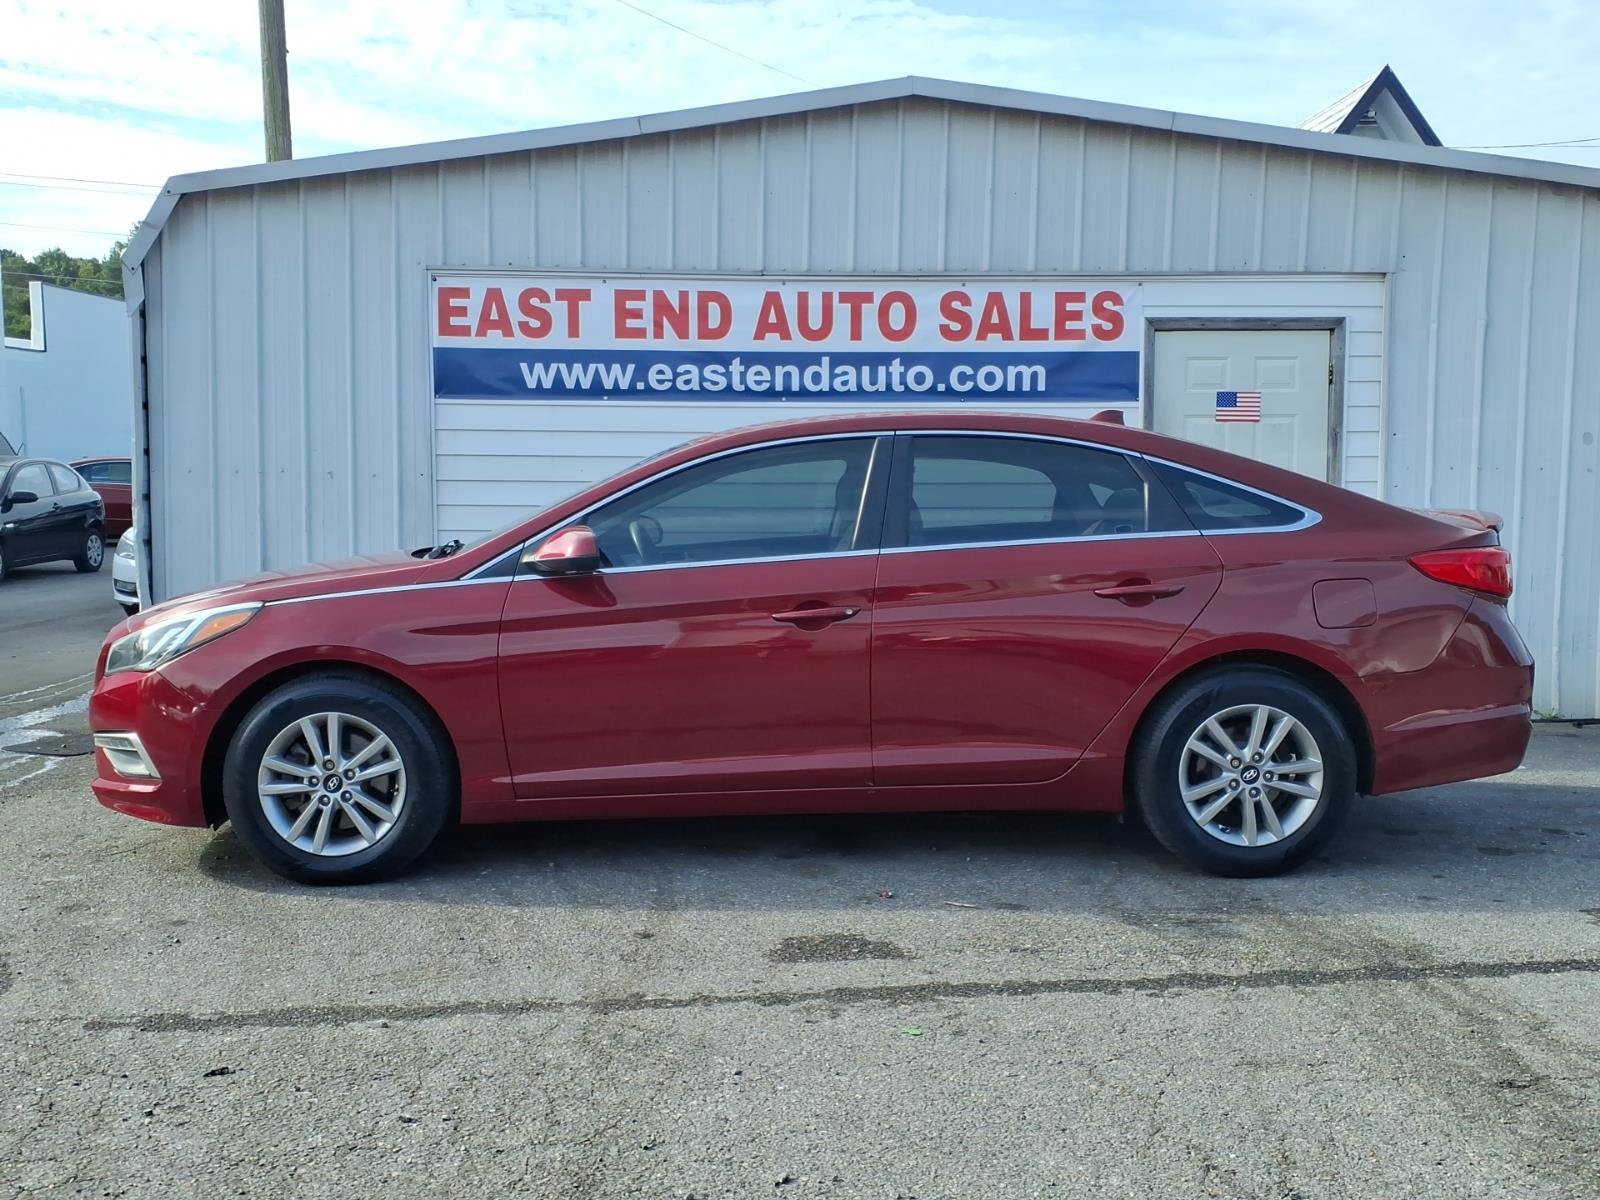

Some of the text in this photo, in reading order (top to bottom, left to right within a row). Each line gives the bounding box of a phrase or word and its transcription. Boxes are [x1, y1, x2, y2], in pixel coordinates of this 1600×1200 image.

[438, 287, 1125, 341] EAST END AUTO SALES
[519, 356, 1047, 393] www.eastendauto.com
